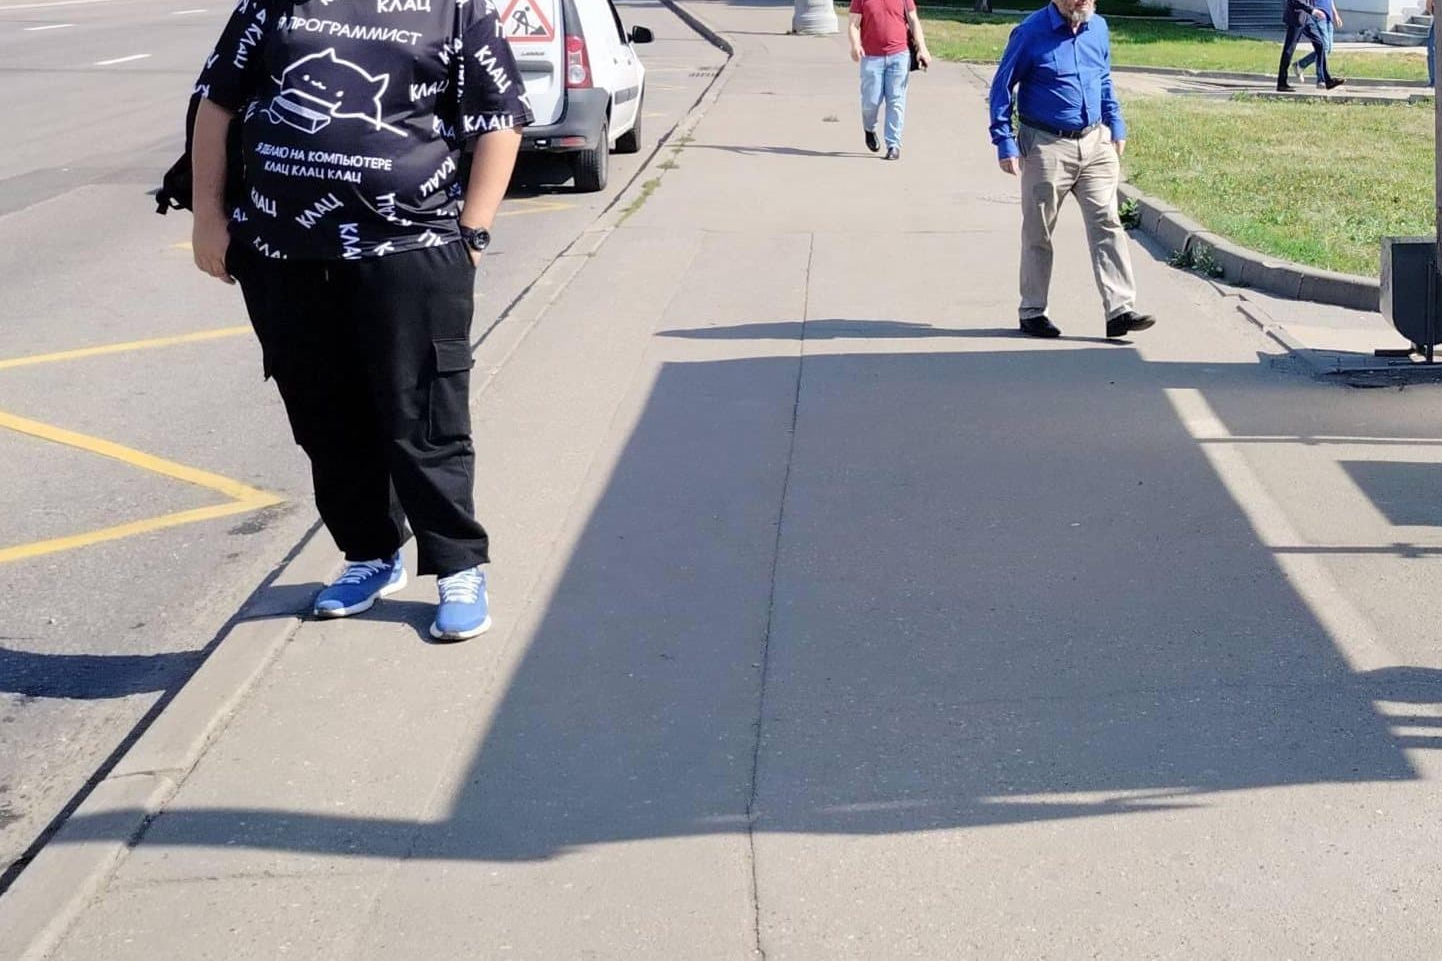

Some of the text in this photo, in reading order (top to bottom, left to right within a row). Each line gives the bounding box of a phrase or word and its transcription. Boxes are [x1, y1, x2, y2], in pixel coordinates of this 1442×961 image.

[286, 16, 423, 46] ПРОГРАММИСТ
[474, 45, 512, 94] КЛАЦ
[409, 79, 449, 102] КЛАЦ
[463, 115, 514, 132] КЛАЦ
[264, 161, 362, 184] КЛАЦ КЛАЦ КЛАЦ
[290, 148, 305, 161] НА
[307, 150, 392, 171] КОМПЬЮТЕРЕ
[420, 156, 456, 197] КЛАЦ
[295, 192, 344, 229] КЛАЦ
